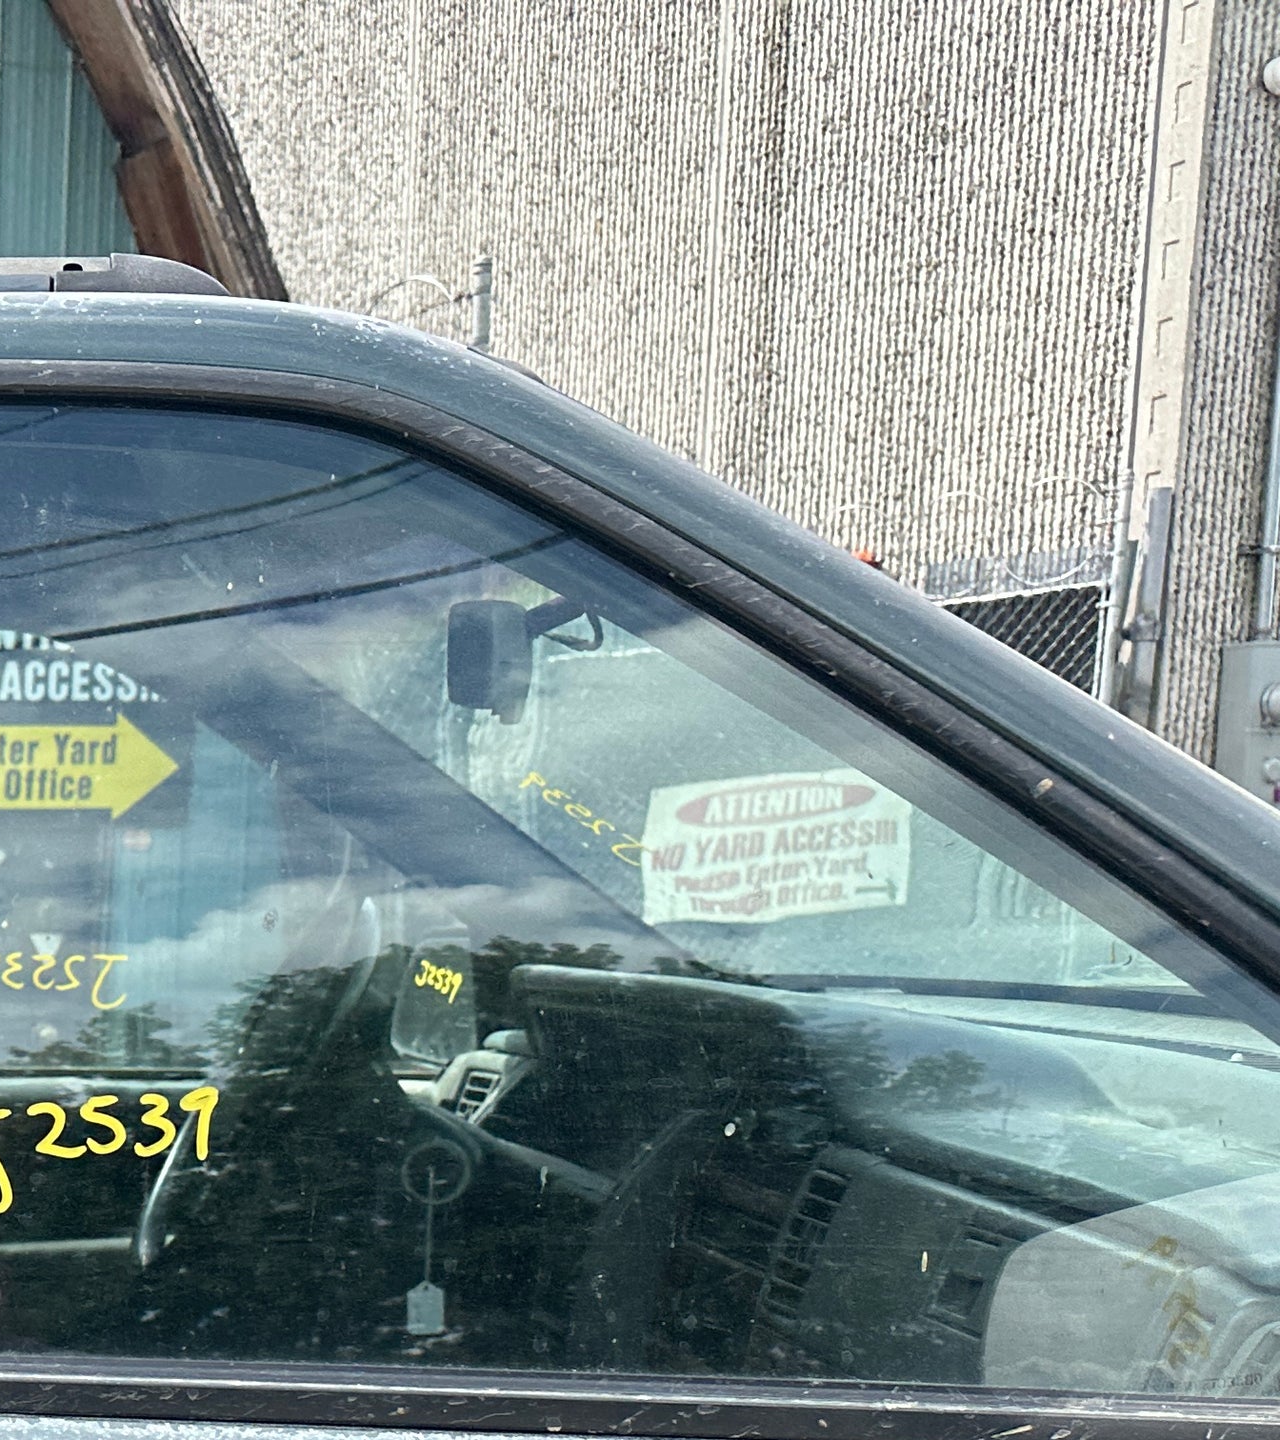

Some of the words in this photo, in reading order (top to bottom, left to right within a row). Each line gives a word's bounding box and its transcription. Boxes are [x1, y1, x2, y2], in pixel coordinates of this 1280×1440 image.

[54, 733, 118, 766] Yard
[4, 772, 93, 802] Office
[704, 785, 844, 825] ATTENTION
[650, 840, 687, 872] NO
[693, 830, 766, 867] YARD
[414, 959, 463, 1004] J2539
